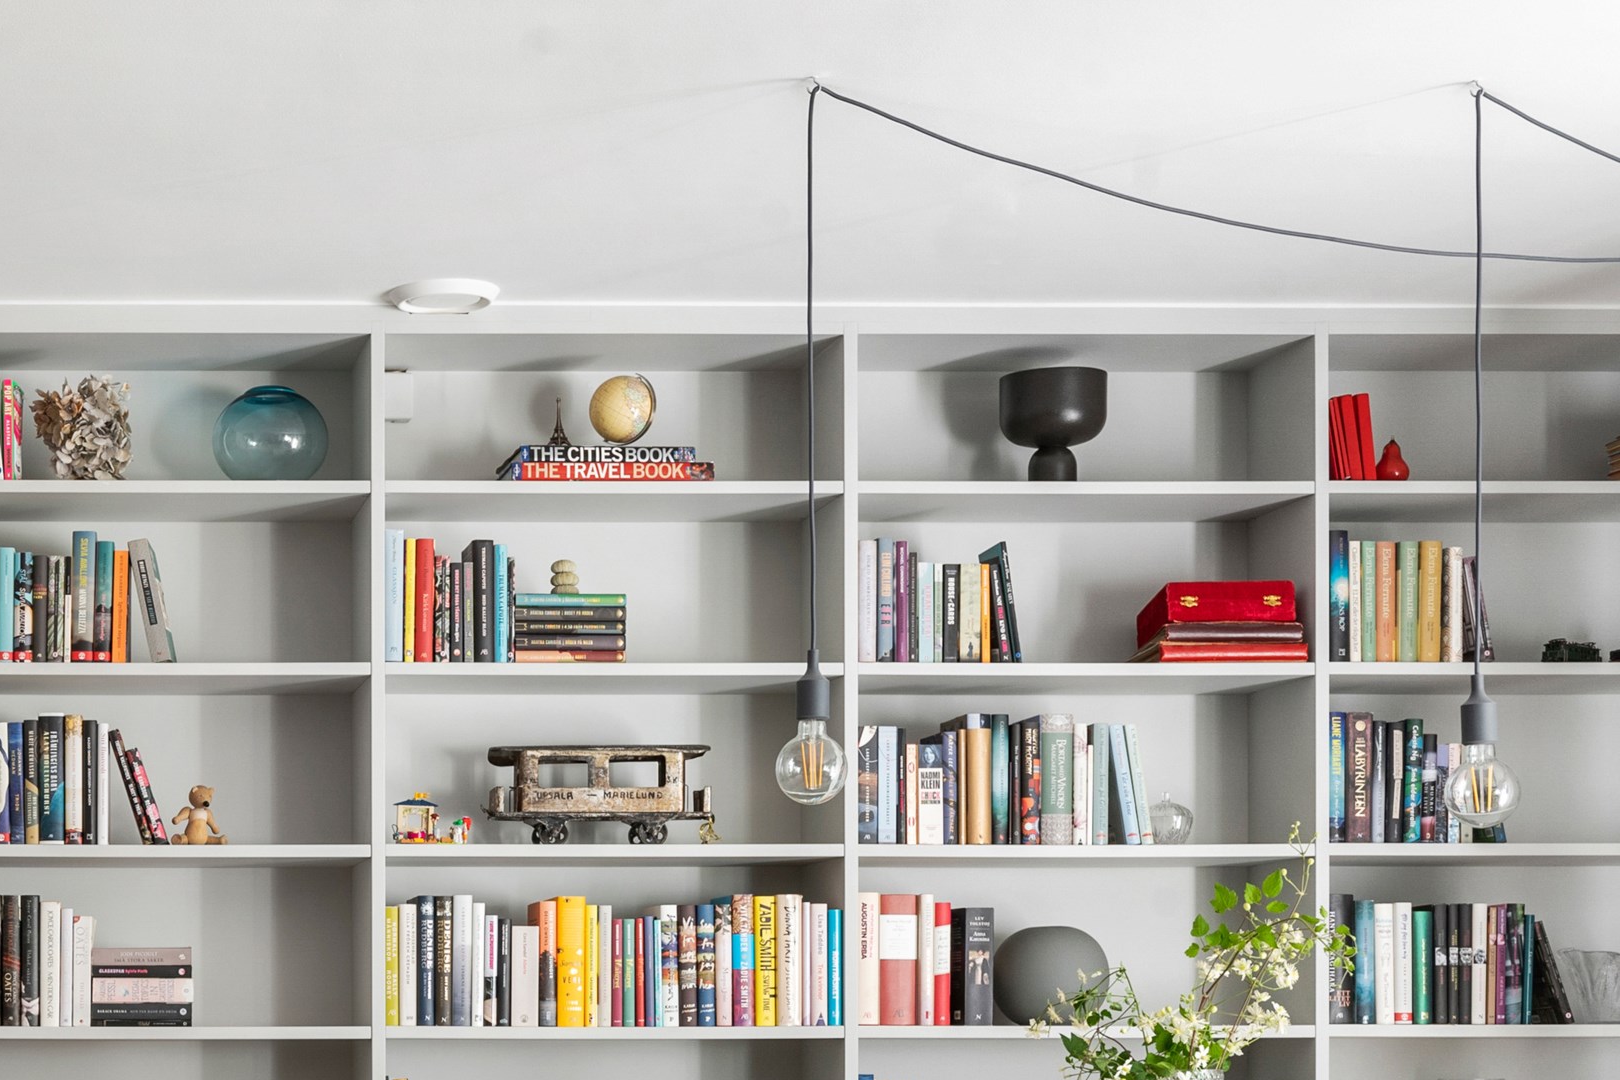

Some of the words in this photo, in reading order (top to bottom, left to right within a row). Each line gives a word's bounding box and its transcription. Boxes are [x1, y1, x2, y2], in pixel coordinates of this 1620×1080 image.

[4, 385, 12, 400] POP
[4, 402, 12, 416] ART
[530, 446, 565, 462] THE
[567, 446, 622, 462] CITIES
[624, 446, 674, 462] BOOK
[524, 462, 561, 479] THE
[562, 462, 632, 479] TRAVEL
[632, 462, 685, 479] BOOK
[80, 538, 88, 556] SILVIA
[80, 557, 88, 587] AVALLONE
[1365, 547, 1375, 575] Elena
[1382, 548, 1392, 575] Elena
[1406, 548, 1416, 575] Elena
[1428, 547, 1438, 575] Elena
[19, 569, 27, 584] STÅL
[947, 577, 955, 599] HOUSE
[19, 587, 27, 607] SILVIA
[1365, 577, 1375, 617] Ferrante
[1382, 577, 1392, 618] Ferrante
[1406, 577, 1416, 617] Ferrante
[1428, 577, 1438, 617] Ferrante
[19, 607, 27, 643] AVALLONE
[78, 609, 86, 634] BELLEZZA
[947, 602, 955, 625] CARDS
[1331, 716, 1341, 737] LIANE
[1411, 725, 1419, 749] Celeste
[50, 731, 59, 773] FRÄMLINGENS
[1056, 739, 1066, 765] BORTA
[1331, 739, 1341, 775] MORIARTY
[1410, 750, 1418, 761] Ng
[50, 775, 59, 791] BARN
[921, 780, 940, 789] KLEIN
[1056, 777, 1066, 808] VINDEN
[1355, 744, 1366, 817] LABYRINTEN
[536, 791, 574, 801] UPSALA
[603, 790, 663, 800] MARIELUND
[740, 904, 748, 919] VITA
[760, 904, 772, 937] ZADIE
[76, 927, 85, 966] OATES
[426, 919, 434, 969] DENISE
[740, 920, 748, 952] TÄNDER
[760, 939, 772, 971] SMITH
[614, 959, 622, 988] Maigret
[625, 959, 633, 988] Maigret
[740, 961, 748, 983] ZADIE
[763, 974, 771, 995] SWING
[4, 972, 12, 1003] OATES
[740, 985, 748, 1008] SMITH
[763, 997, 771, 1011] TIME
